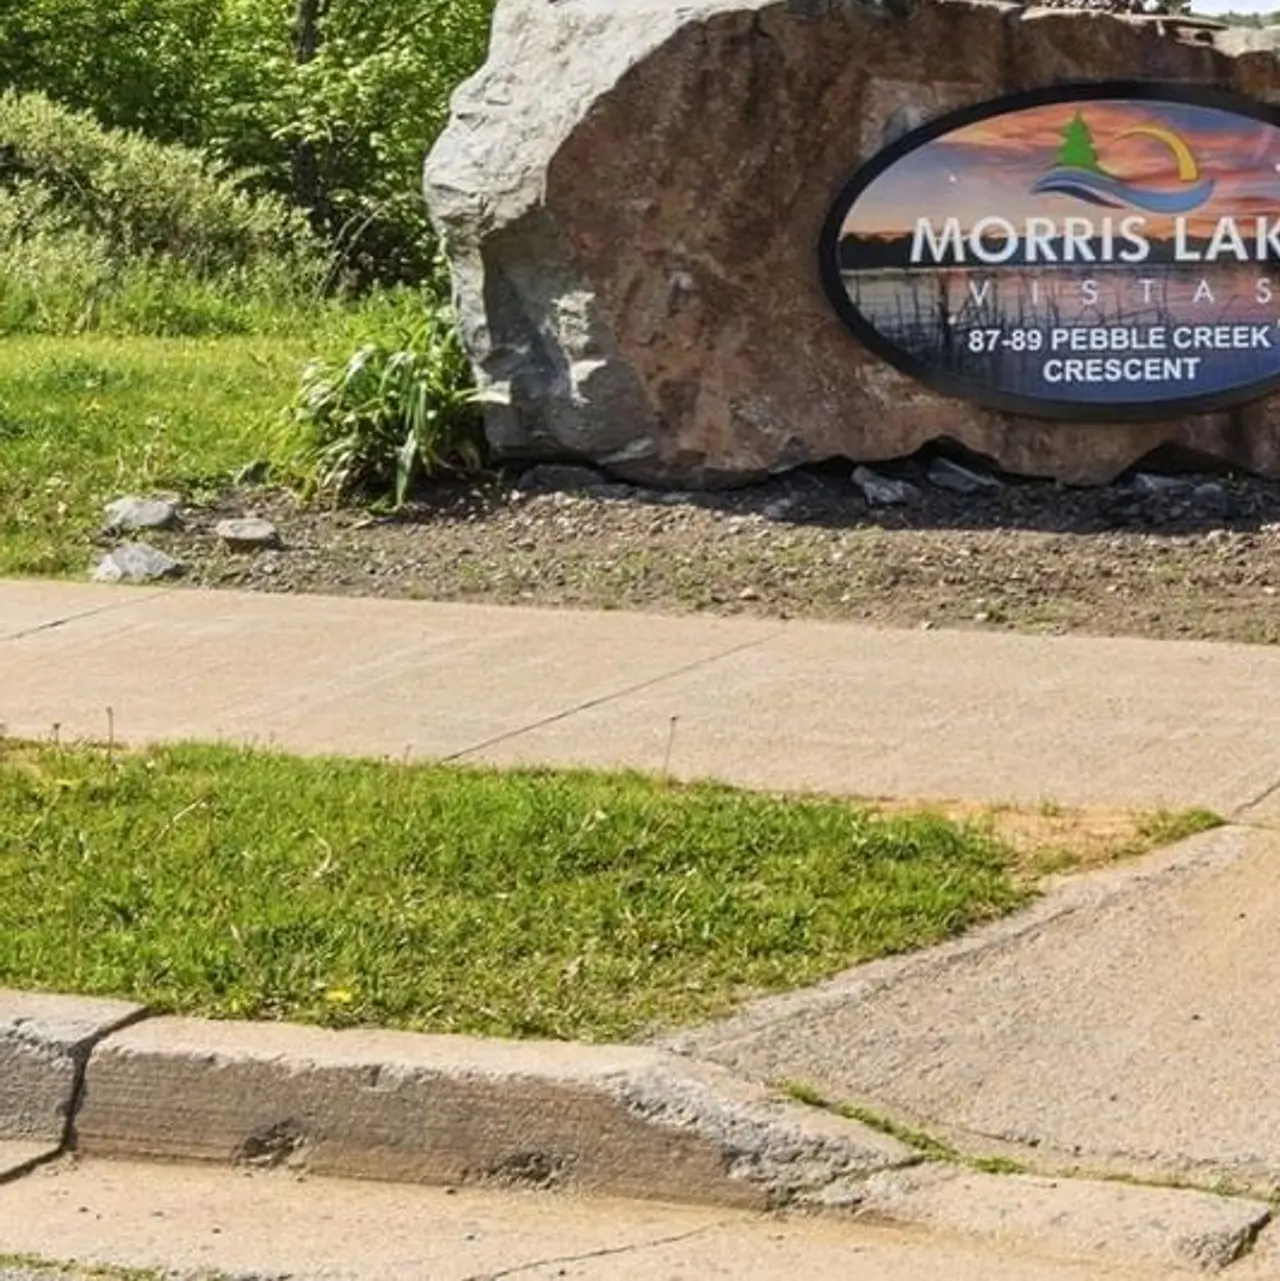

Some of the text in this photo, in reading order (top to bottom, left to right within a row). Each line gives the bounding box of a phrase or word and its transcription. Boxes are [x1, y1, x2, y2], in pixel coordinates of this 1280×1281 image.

[910, 215, 1150, 263] MORRIS
[969, 277, 1274, 307] VISTAS
[968, 325, 1271, 352] 87-89 PEBBLE CREEK
[1042, 357, 1202, 382] CRESCENT
